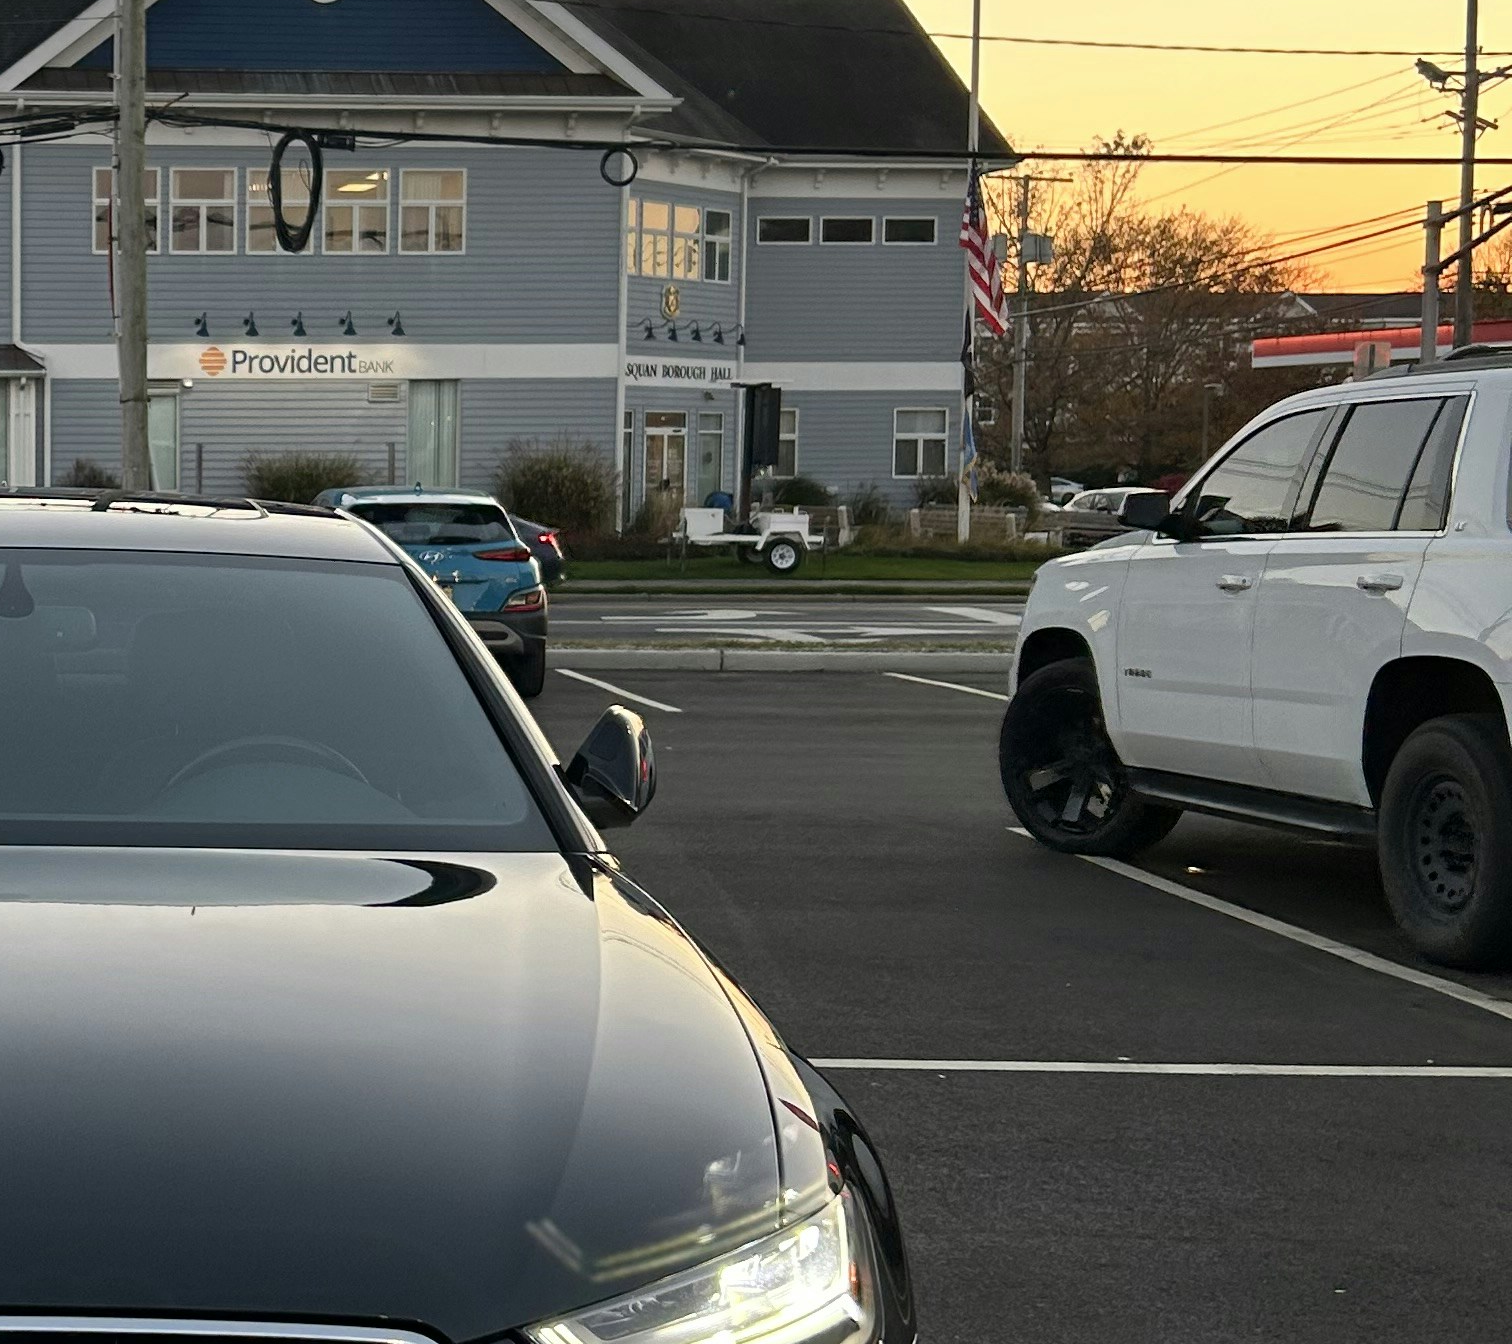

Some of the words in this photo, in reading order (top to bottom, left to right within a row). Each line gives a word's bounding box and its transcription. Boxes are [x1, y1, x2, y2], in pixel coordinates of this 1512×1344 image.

[231, 348, 356, 374] Provident
[358, 360, 394, 374] BANK
[625, 362, 657, 381] SQUAN
[662, 364, 706, 379] BOROUGH
[710, 367, 733, 382] HALL
